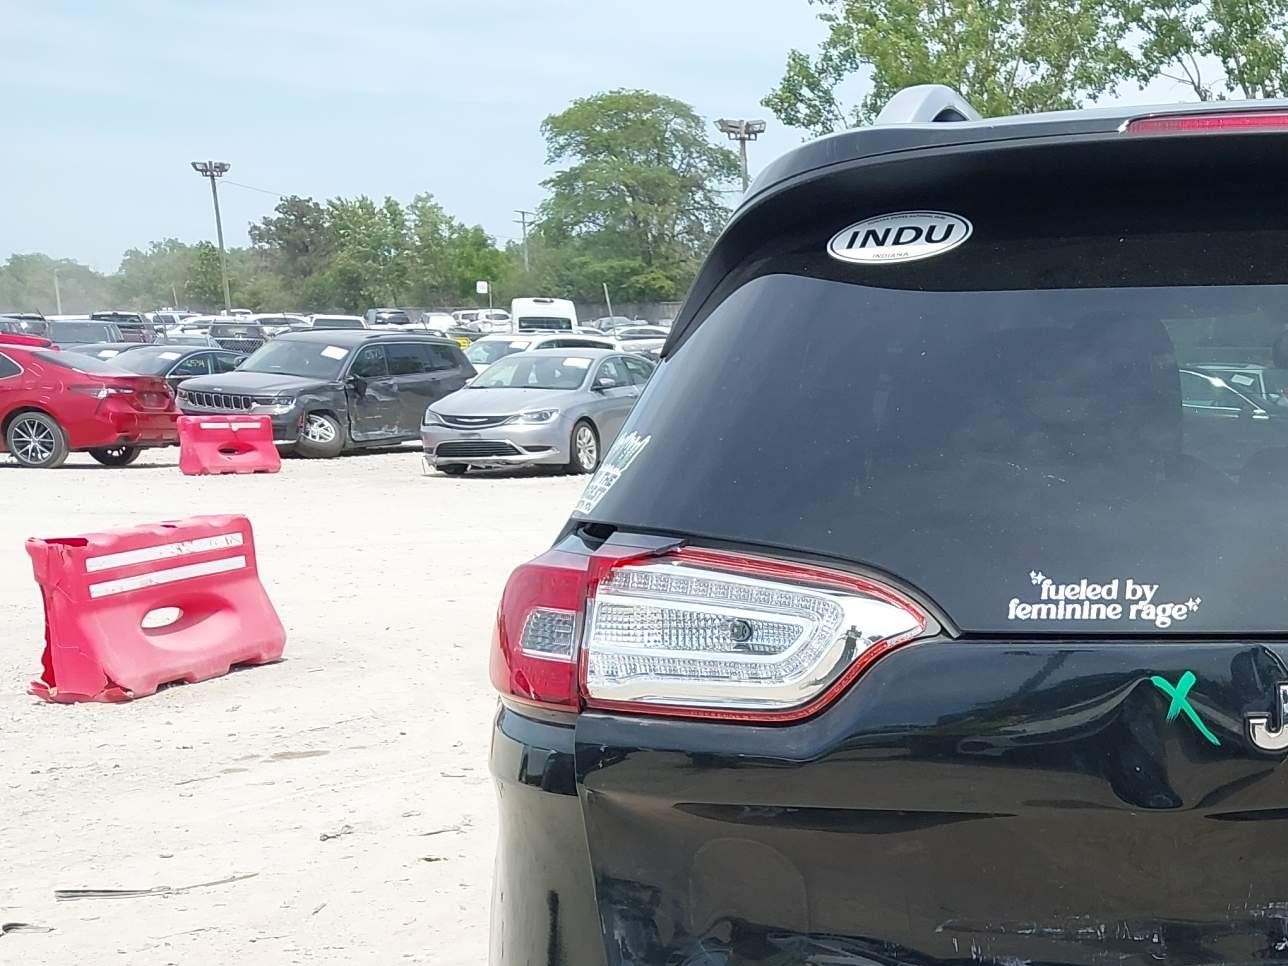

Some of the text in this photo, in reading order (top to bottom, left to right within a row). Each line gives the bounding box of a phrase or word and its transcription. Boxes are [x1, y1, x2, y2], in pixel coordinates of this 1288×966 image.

[845, 224, 956, 249] INDU
[1040, 579, 1159, 606] fueled by
[1007, 597, 1188, 629] feminine rage
